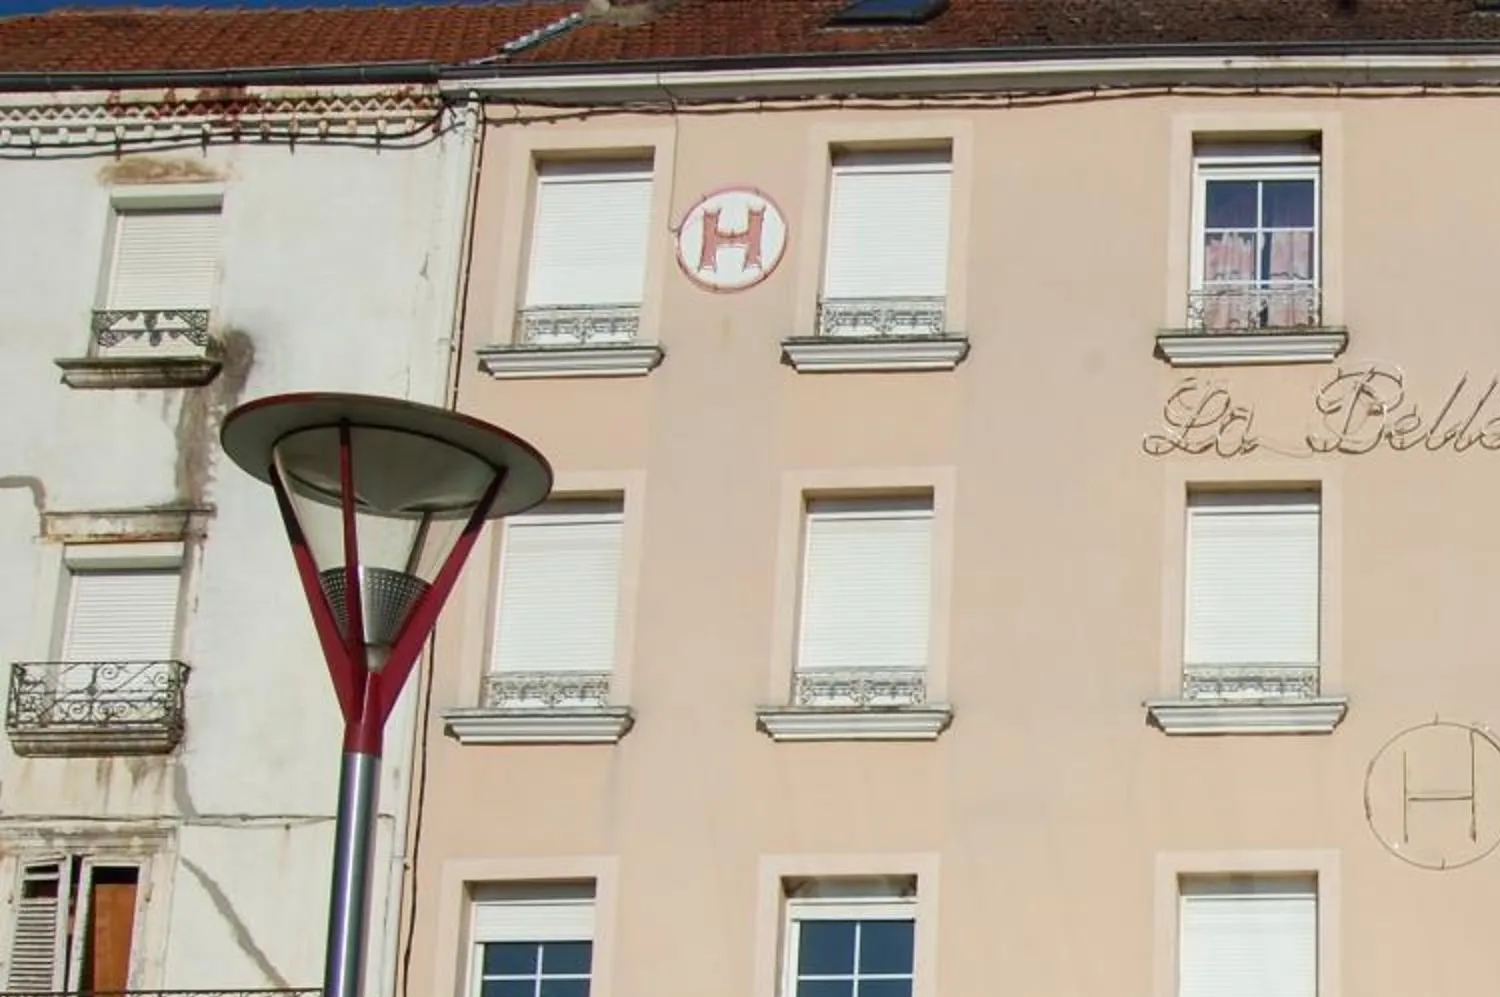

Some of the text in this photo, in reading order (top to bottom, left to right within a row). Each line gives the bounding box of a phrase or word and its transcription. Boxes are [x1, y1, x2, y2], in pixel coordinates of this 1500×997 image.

[697, 205, 767, 272] H
[1142, 376, 1261, 459] La
[1402, 728, 1477, 844] H
